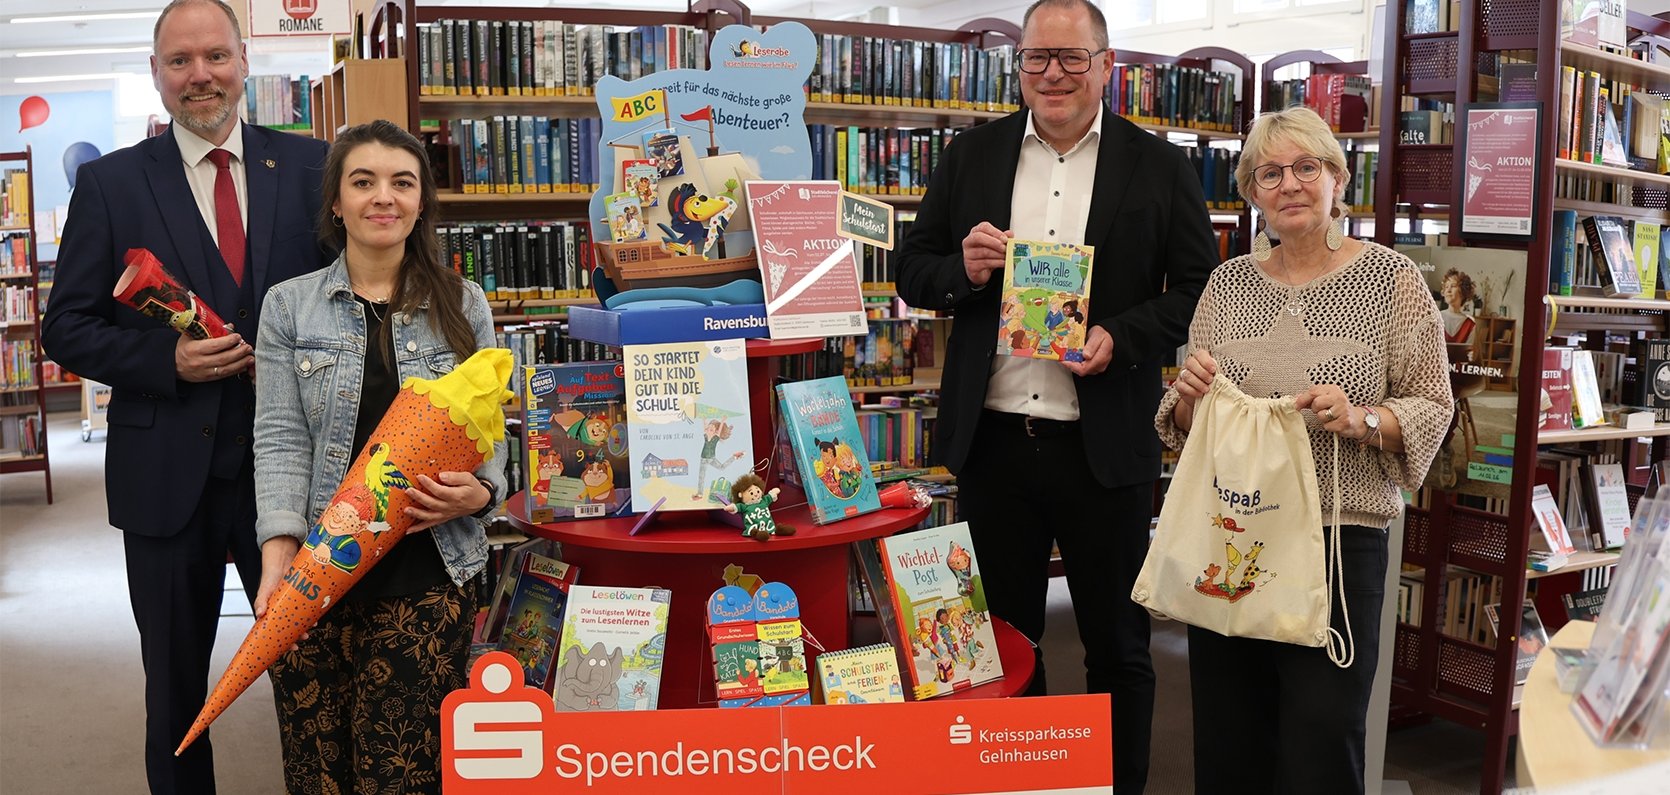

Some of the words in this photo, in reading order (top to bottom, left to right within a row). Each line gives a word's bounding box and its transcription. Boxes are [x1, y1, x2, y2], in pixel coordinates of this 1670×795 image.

[279, 18, 323, 32] ROMANE
[753, 46, 789, 57] Leserabe
[684, 81, 700, 94] für
[702, 83, 719, 97] das
[721, 90, 760, 107] nächste
[763, 94, 792, 109] große
[621, 95, 656, 118] ABC
[711, 108, 789, 131] Abenteuer?
[1497, 157, 1531, 166] AKTION
[853, 203, 876, 219] Mein
[842, 211, 887, 235] Schulstart
[803, 239, 848, 251] AKTION
[1029, 259, 1051, 276] WIR
[1053, 262, 1070, 278] alle
[1052, 276, 1073, 288] Klasse
[704, 314, 769, 331] Ravensbu
[634, 354, 649, 366] SO
[654, 351, 700, 365] STARTET
[634, 368, 662, 381] DEIN
[667, 367, 695, 380] KIND
[1461, 364, 1504, 378] LERNEN.
[570, 376, 584, 384] Auf
[635, 383, 659, 397] GUT
[664, 383, 678, 395] IN
[682, 381, 701, 395] DIE
[636, 397, 680, 412] SCHULE
[576, 450, 584, 462] 9
[1255, 504, 1280, 515] Bibliothek
[897, 547, 943, 569] Wichtel-
[298, 561, 316, 579] Das
[531, 557, 564, 578] Leselöwen
[283, 566, 322, 601] SAMS
[913, 567, 939, 585] Post
[592, 590, 644, 600] Leselöwen
[592, 608, 624, 616] lustigsten
[626, 609, 651, 617] Witze
[598, 617, 650, 626] Lesenlernen
[739, 644, 759, 655] HUND
[840, 661, 892, 678] SCHULSTART-
[857, 675, 887, 688] FERIEN-
[979, 726, 1091, 744] Kreissparkasse
[555, 735, 877, 786] Spendenscheck
[979, 748, 1068, 764] Gelnhausen
